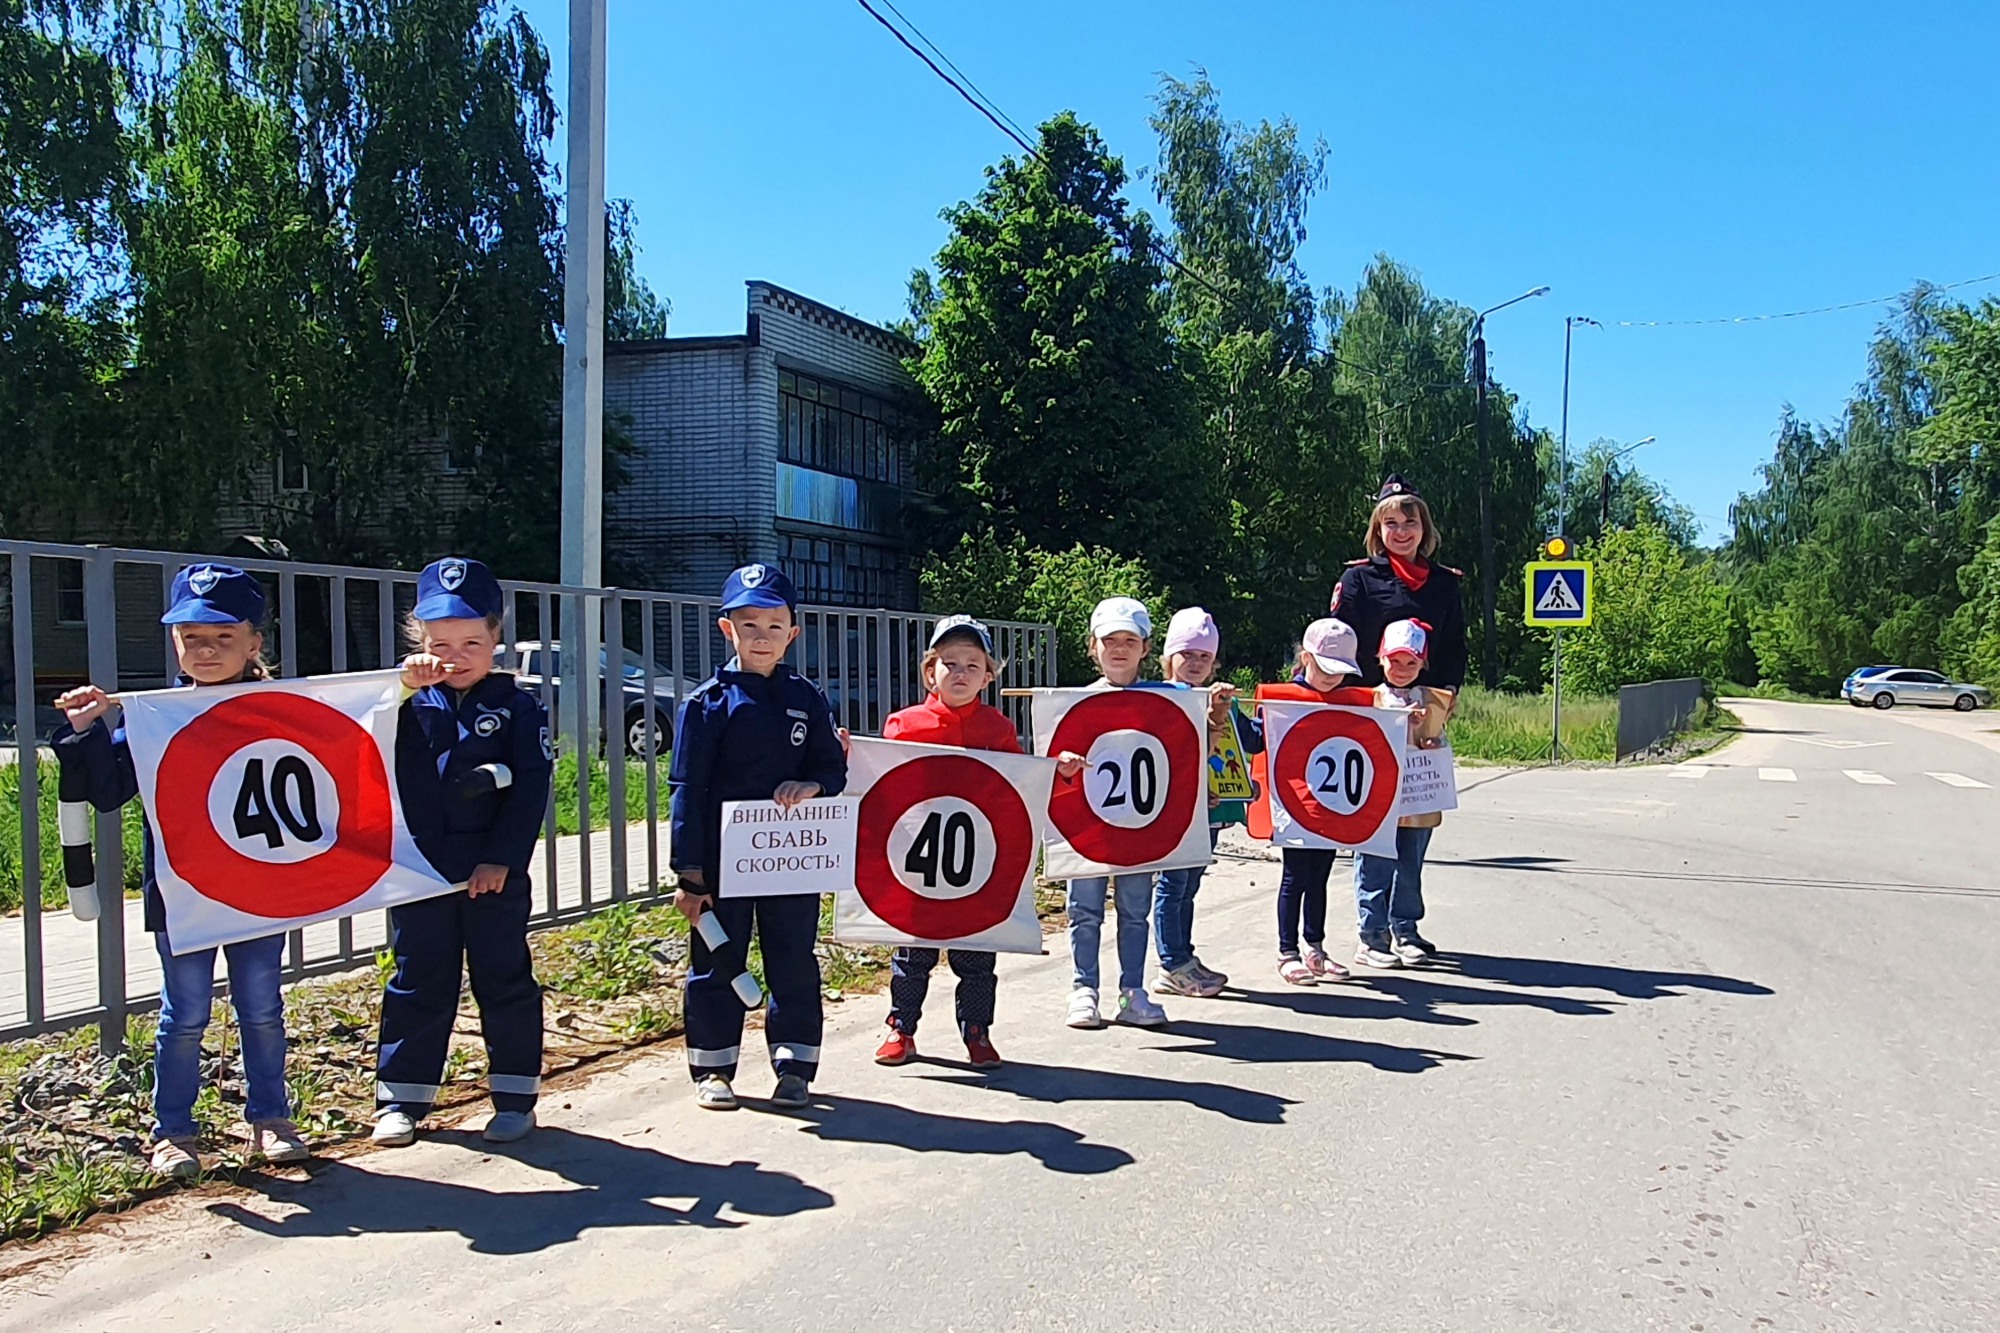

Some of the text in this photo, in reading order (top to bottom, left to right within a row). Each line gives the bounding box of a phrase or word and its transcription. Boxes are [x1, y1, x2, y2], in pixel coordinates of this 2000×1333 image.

[1404, 755, 1431, 769] ИЗЬ
[1096, 747, 1156, 815] 20
[1315, 749, 1364, 806] 20
[1218, 782, 1244, 794] ДЕТИ
[233, 754, 323, 849] 40
[732, 805, 848, 823] ВНИМАНИЕ!
[751, 829, 827, 849] СБАВЬ
[905, 811, 975, 887] 40
[735, 854, 840, 873] СКОРОСТЬ!
